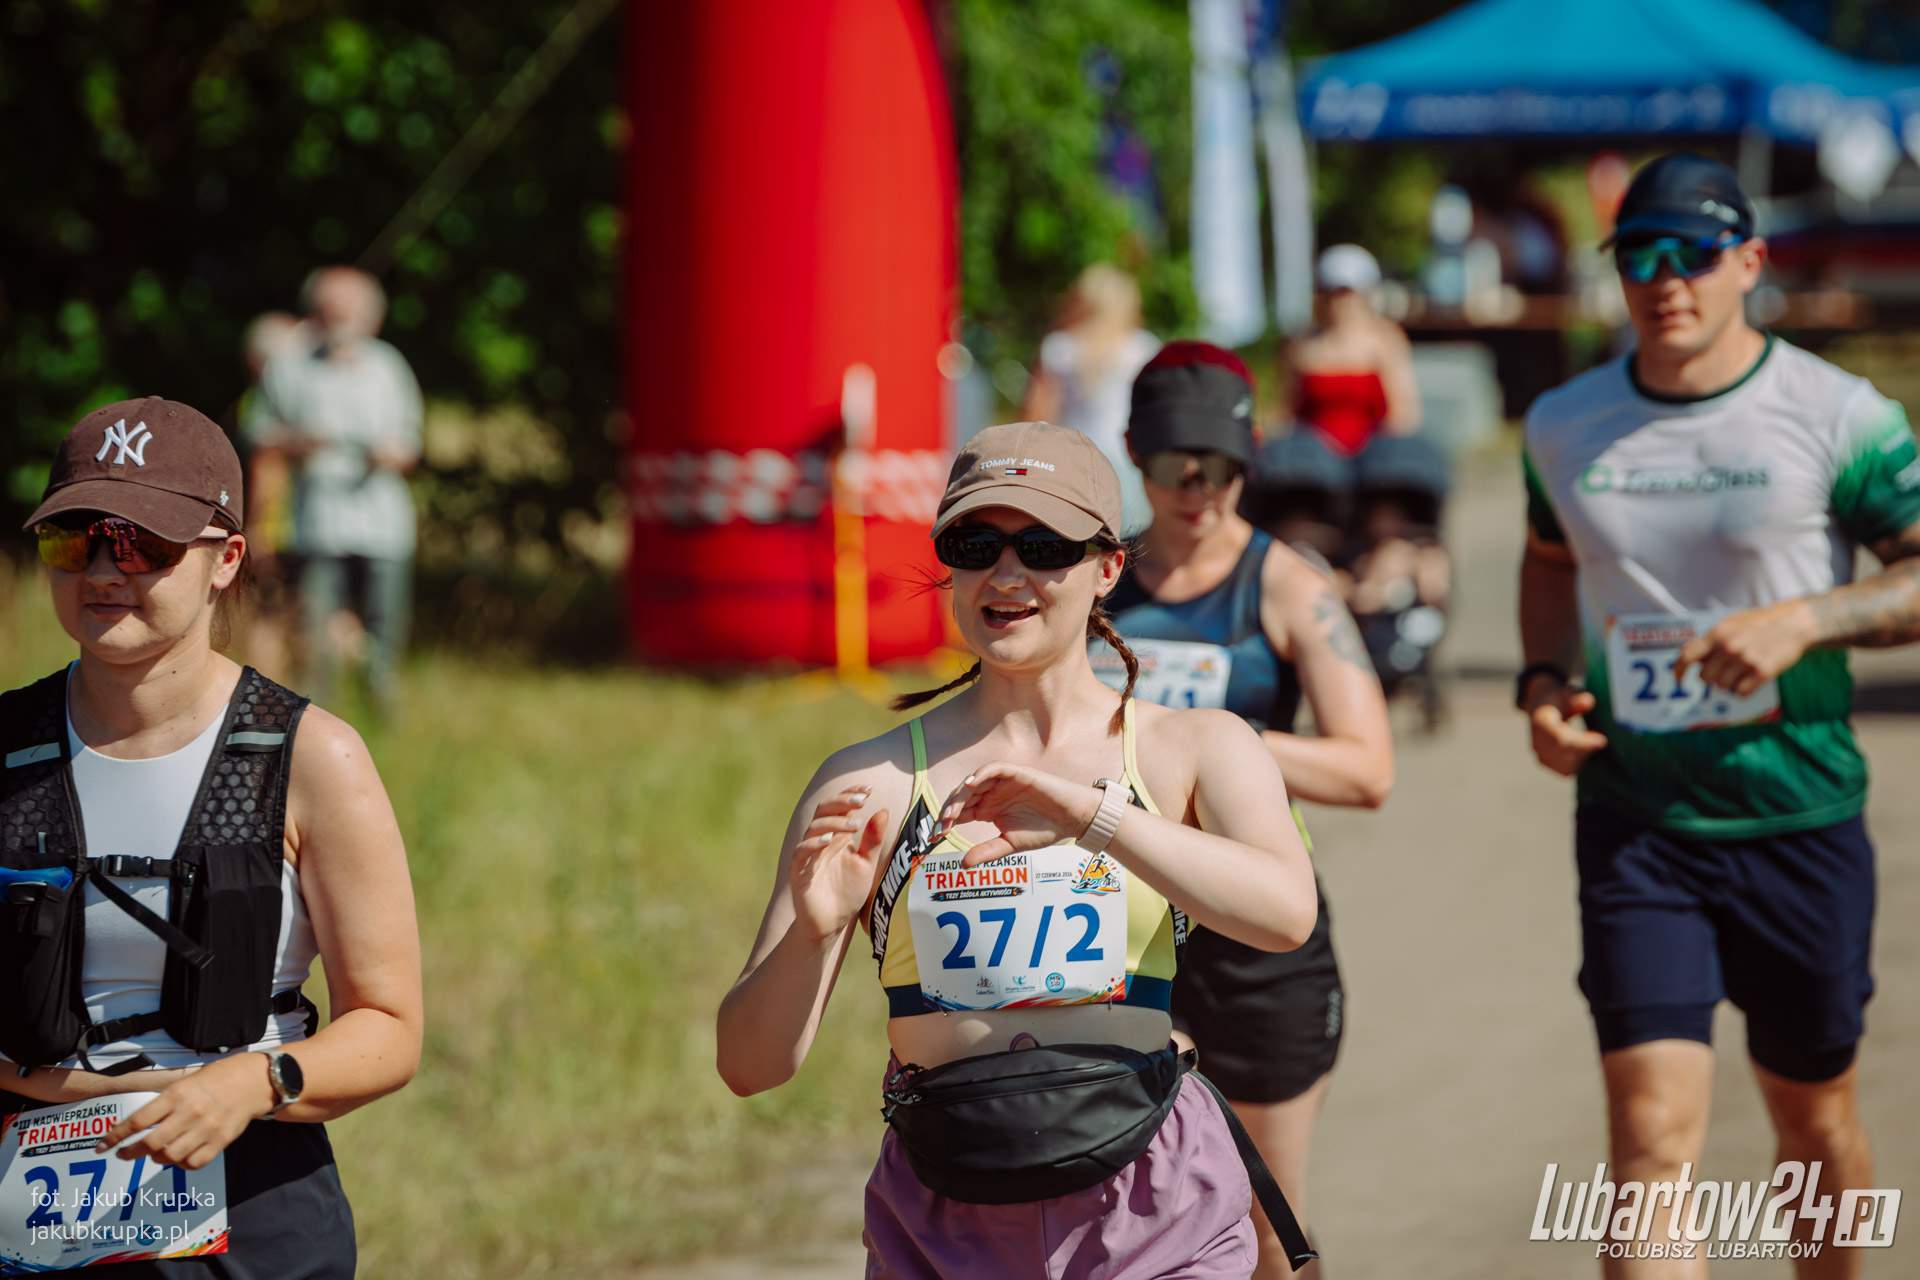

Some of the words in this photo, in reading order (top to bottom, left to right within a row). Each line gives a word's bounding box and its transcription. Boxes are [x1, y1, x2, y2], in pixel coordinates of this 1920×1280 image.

[95, 418, 153, 467] NY
[980, 457, 1017, 470] TOMMY
[1020, 458, 1055, 471] JEANS
[881, 840, 912, 906] NIKE
[925, 861, 937, 873] III
[925, 867, 1028, 890] TRIATHLON
[945, 892, 959, 900] TRZY
[935, 902, 1104, 970] 27/2
[33, 1103, 117, 1126] NADWIEPRZAŃSKI
[24, 1158, 197, 1229] 27/1
